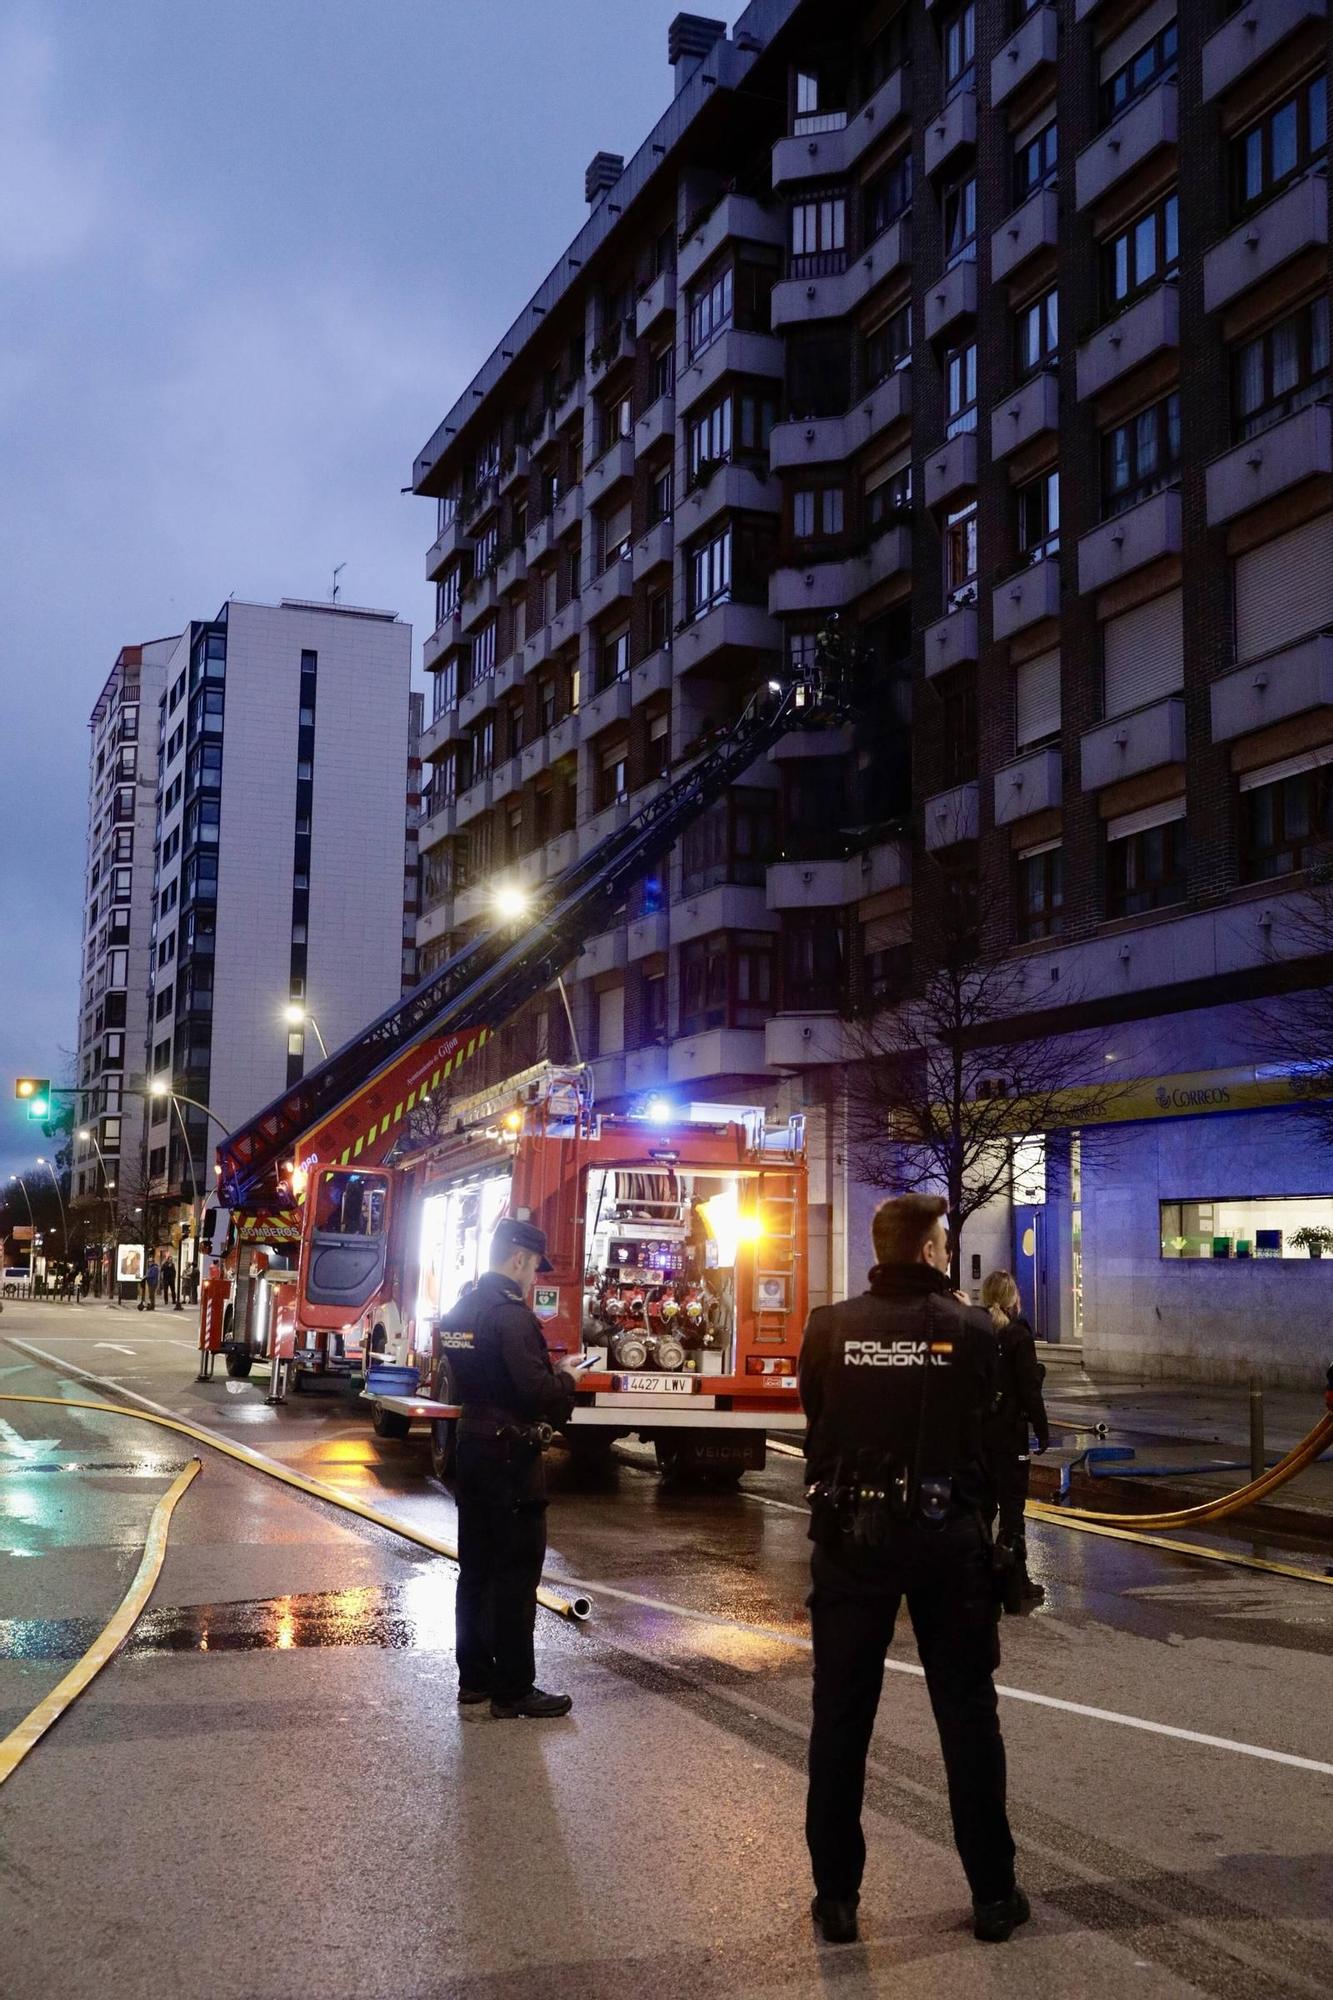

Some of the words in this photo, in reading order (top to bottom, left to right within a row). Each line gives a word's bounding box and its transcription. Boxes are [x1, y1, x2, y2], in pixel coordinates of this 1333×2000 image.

[1172, 1087, 1230, 1108] CORREOS
[240, 1226, 300, 1237] BOMBEROS
[845, 1341, 928, 1353] POLICIA
[631, 1379, 659, 1391] 4427
[664, 1379, 686, 1391] LWV
